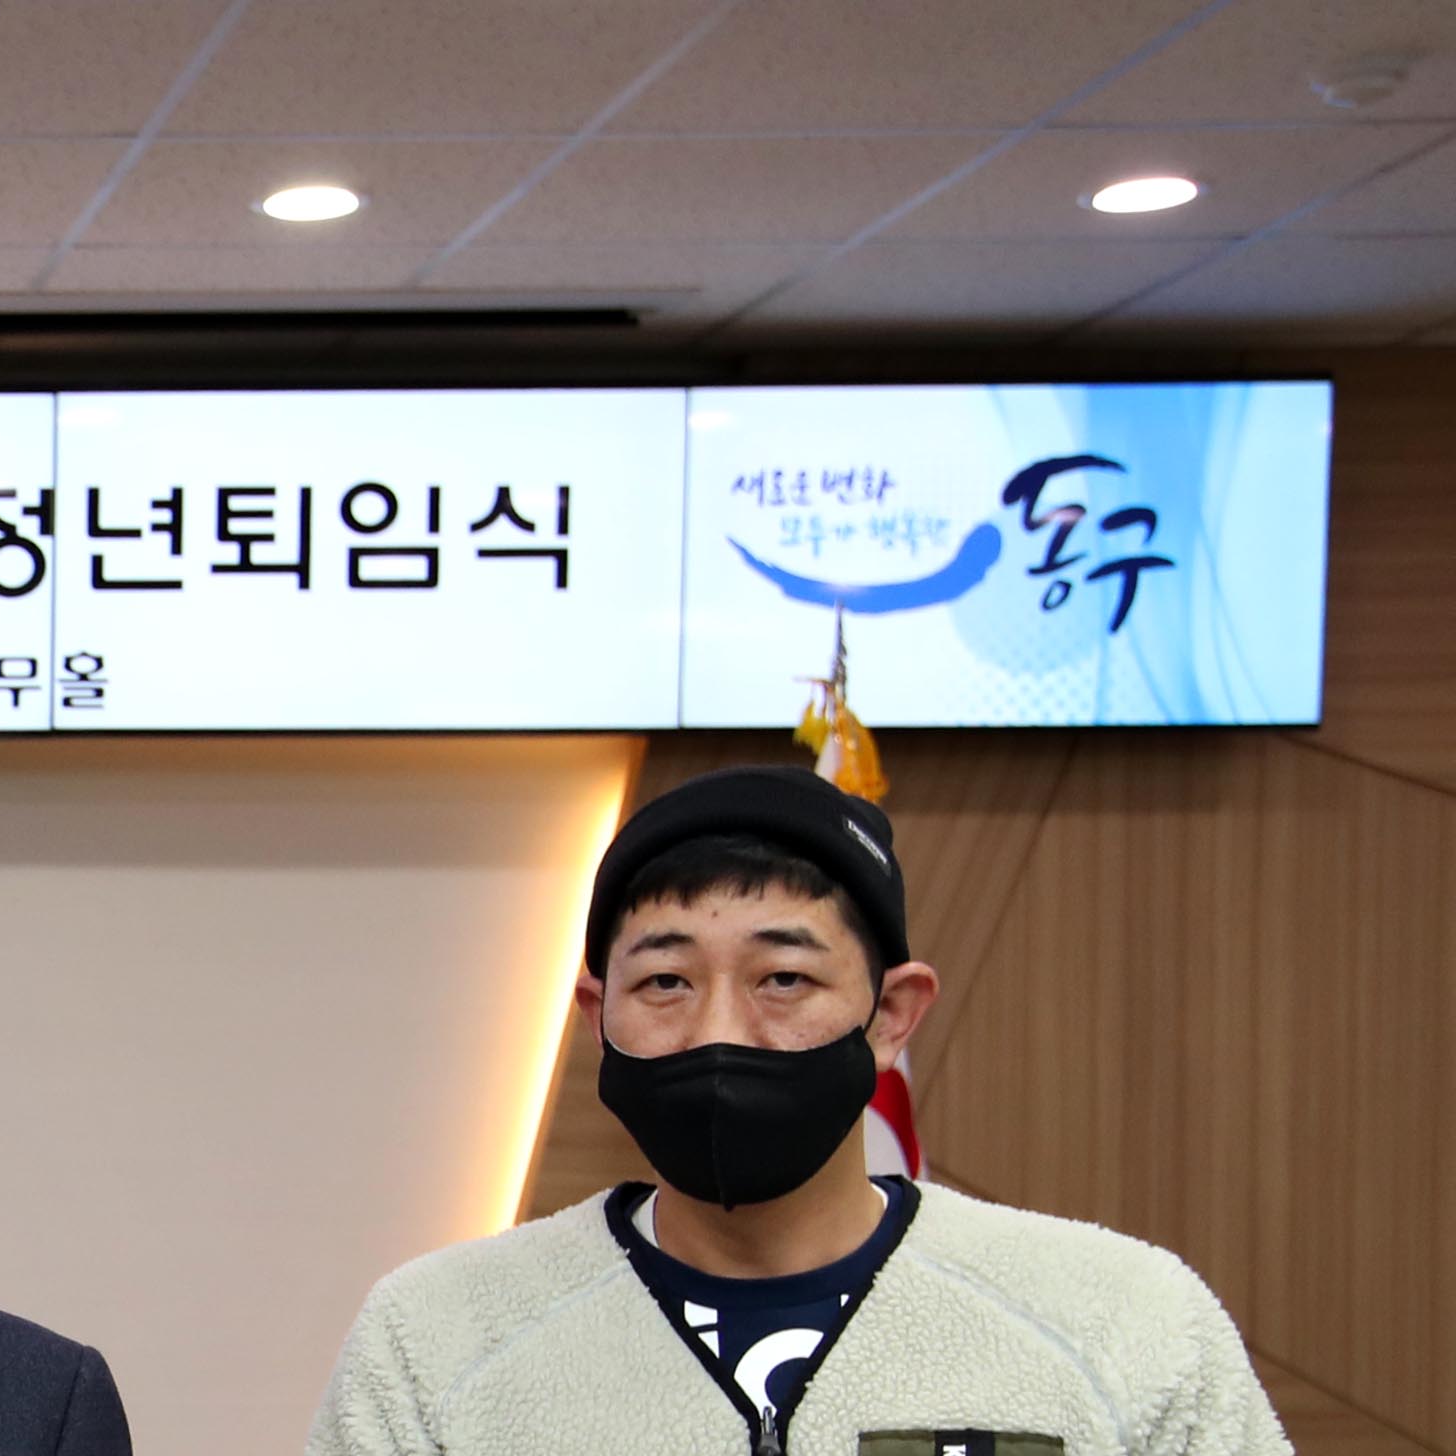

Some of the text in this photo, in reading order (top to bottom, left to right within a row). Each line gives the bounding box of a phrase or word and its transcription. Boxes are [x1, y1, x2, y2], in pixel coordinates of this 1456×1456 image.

[731, 464, 895, 507] 새로운 변화
[1001, 453, 1177, 634] 동구
